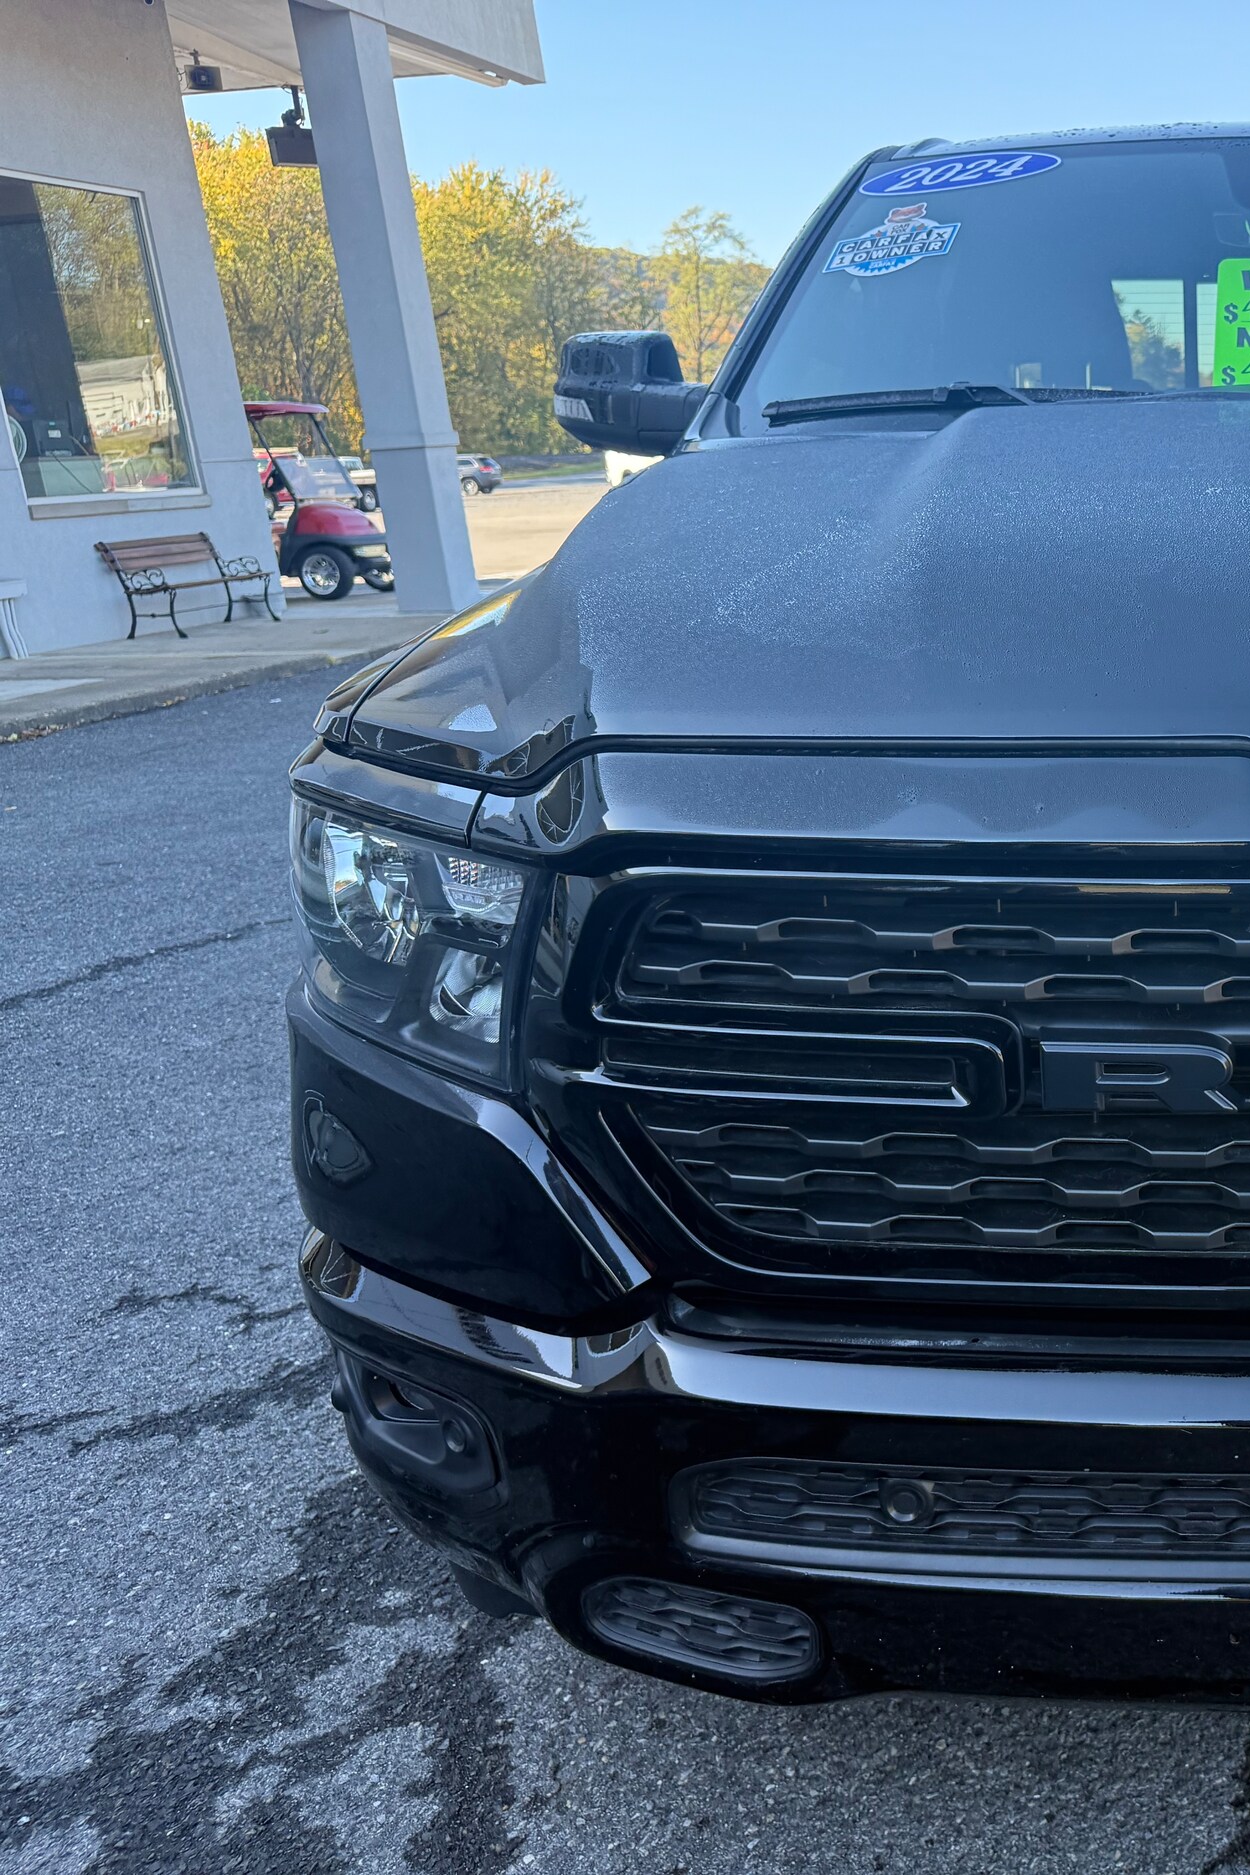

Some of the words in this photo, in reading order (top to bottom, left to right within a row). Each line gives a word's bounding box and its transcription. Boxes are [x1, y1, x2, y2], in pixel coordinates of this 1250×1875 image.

[884, 155, 1033, 193] 2024
[838, 256, 847, 265] 1
[853, 241, 944, 264] OWNER
[842, 231, 947, 253] CARFAX
